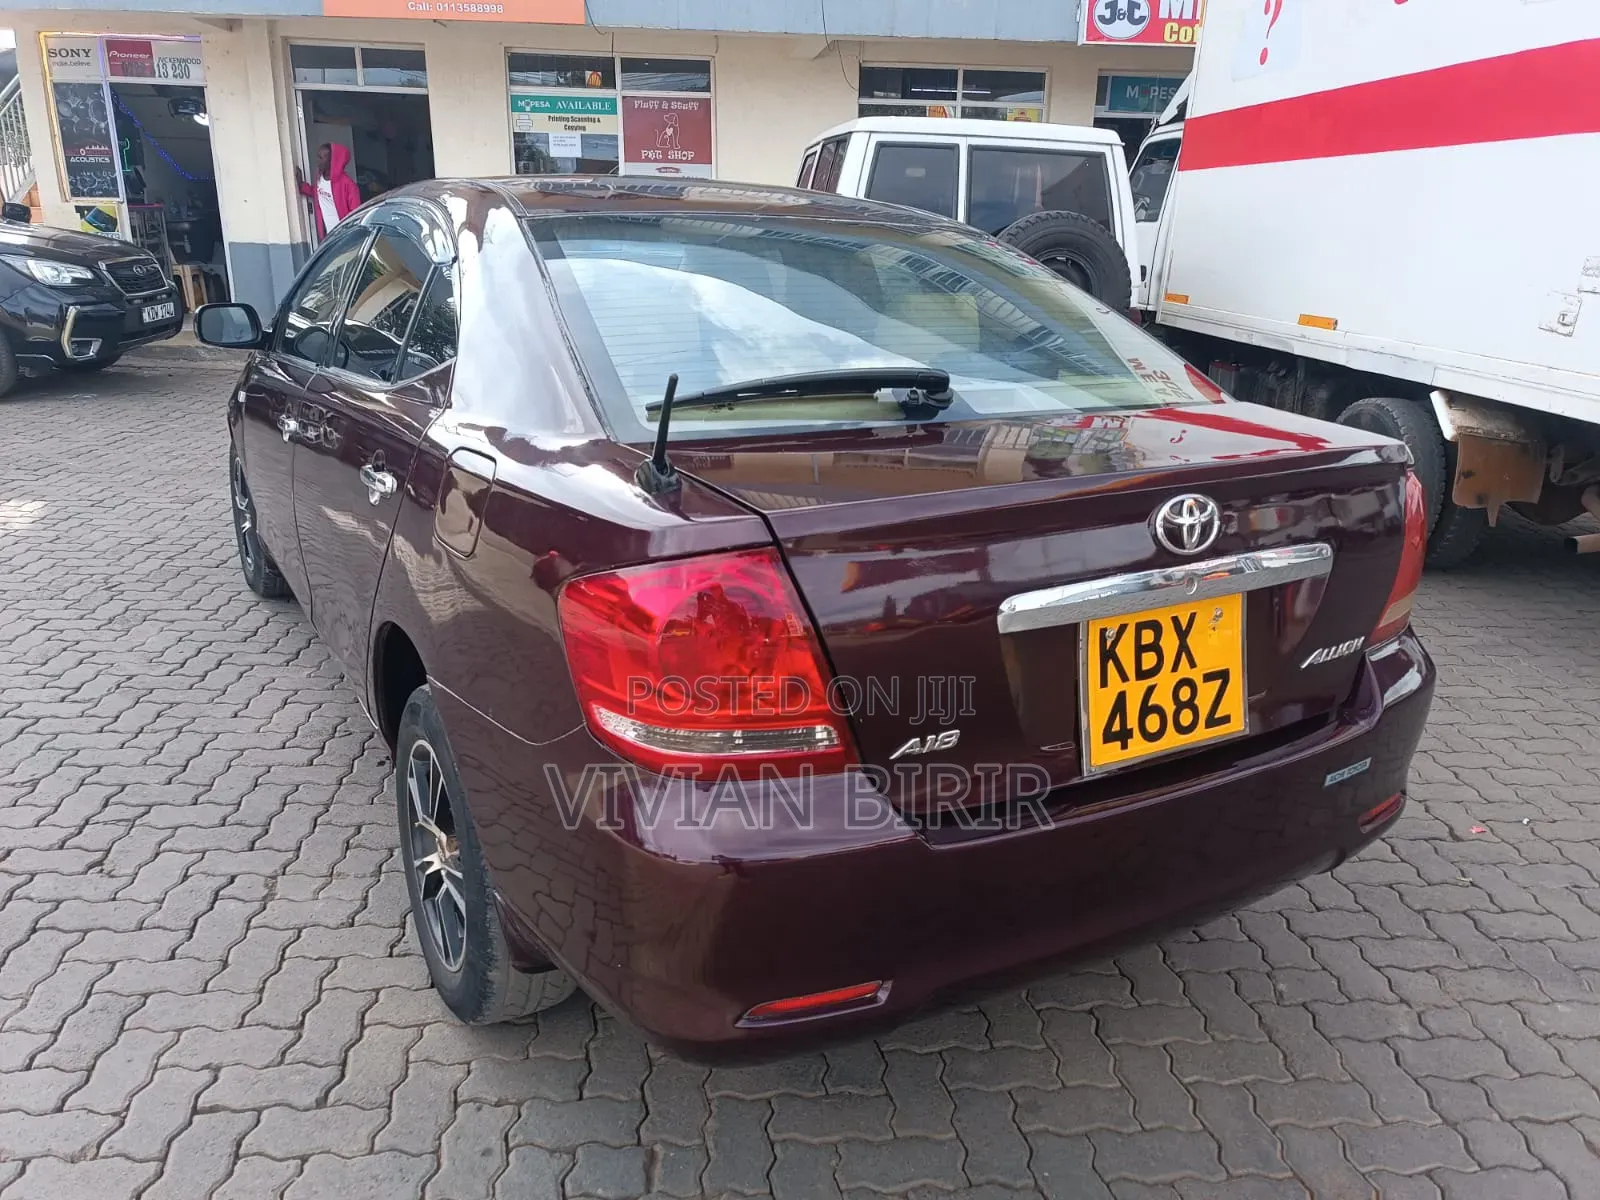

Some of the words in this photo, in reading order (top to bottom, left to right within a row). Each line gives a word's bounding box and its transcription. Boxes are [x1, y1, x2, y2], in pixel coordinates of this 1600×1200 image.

[408, 2, 433, 11] Call:
[436, 3, 504, 14] 0113588998
[1097, 0, 1147, 25] J&C
[48, 48, 92, 58] SONY
[109, 50, 151, 59] Pioneer
[556, 101, 611, 111] AVAILABLE
[661, 100, 669, 110] &
[548, 115, 570, 123] Printing
[570, 116, 594, 124] Scanning
[563, 124, 587, 132] Copying
[667, 150, 695, 161] SHOP
[1099, 612, 1198, 689] KBX
[1102, 668, 1232, 751] 468Z
[889, 729, 960, 760] A18
